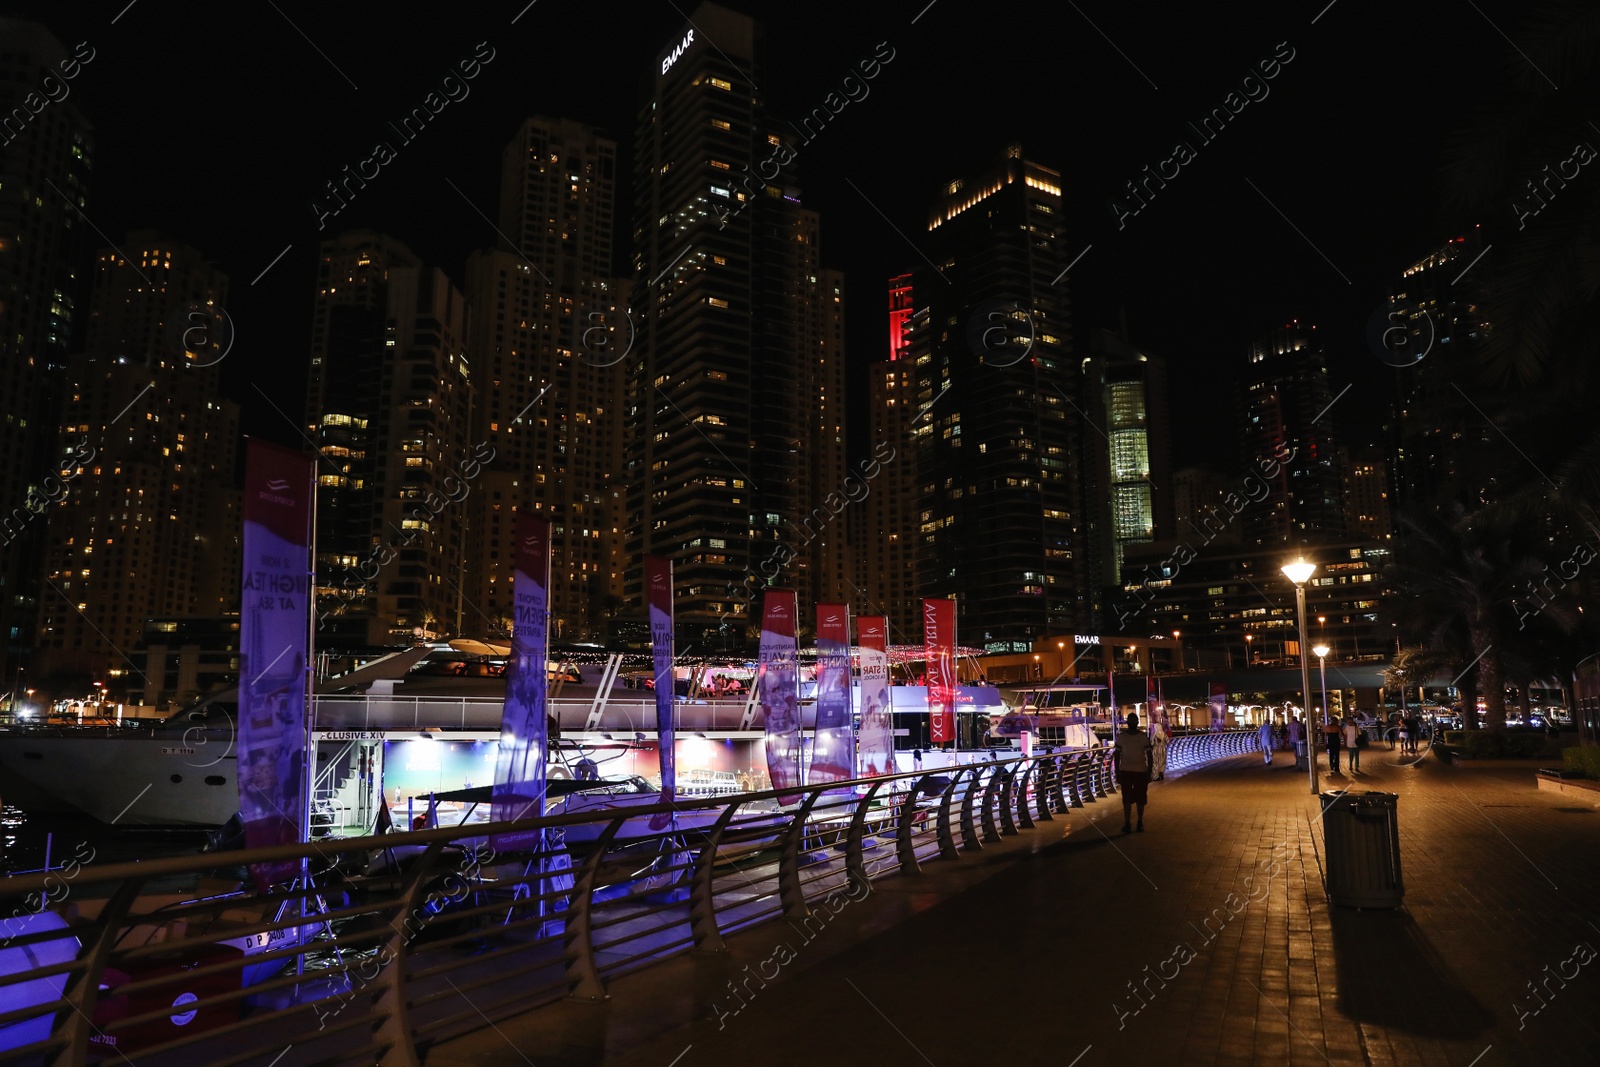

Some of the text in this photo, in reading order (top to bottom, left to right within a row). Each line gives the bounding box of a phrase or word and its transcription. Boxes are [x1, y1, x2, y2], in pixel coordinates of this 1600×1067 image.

[662, 29, 694, 75] EMAAR
[1074, 634, 1100, 645] EMAAR
[246, 937, 253, 949] D
[257, 934, 263, 946] P
